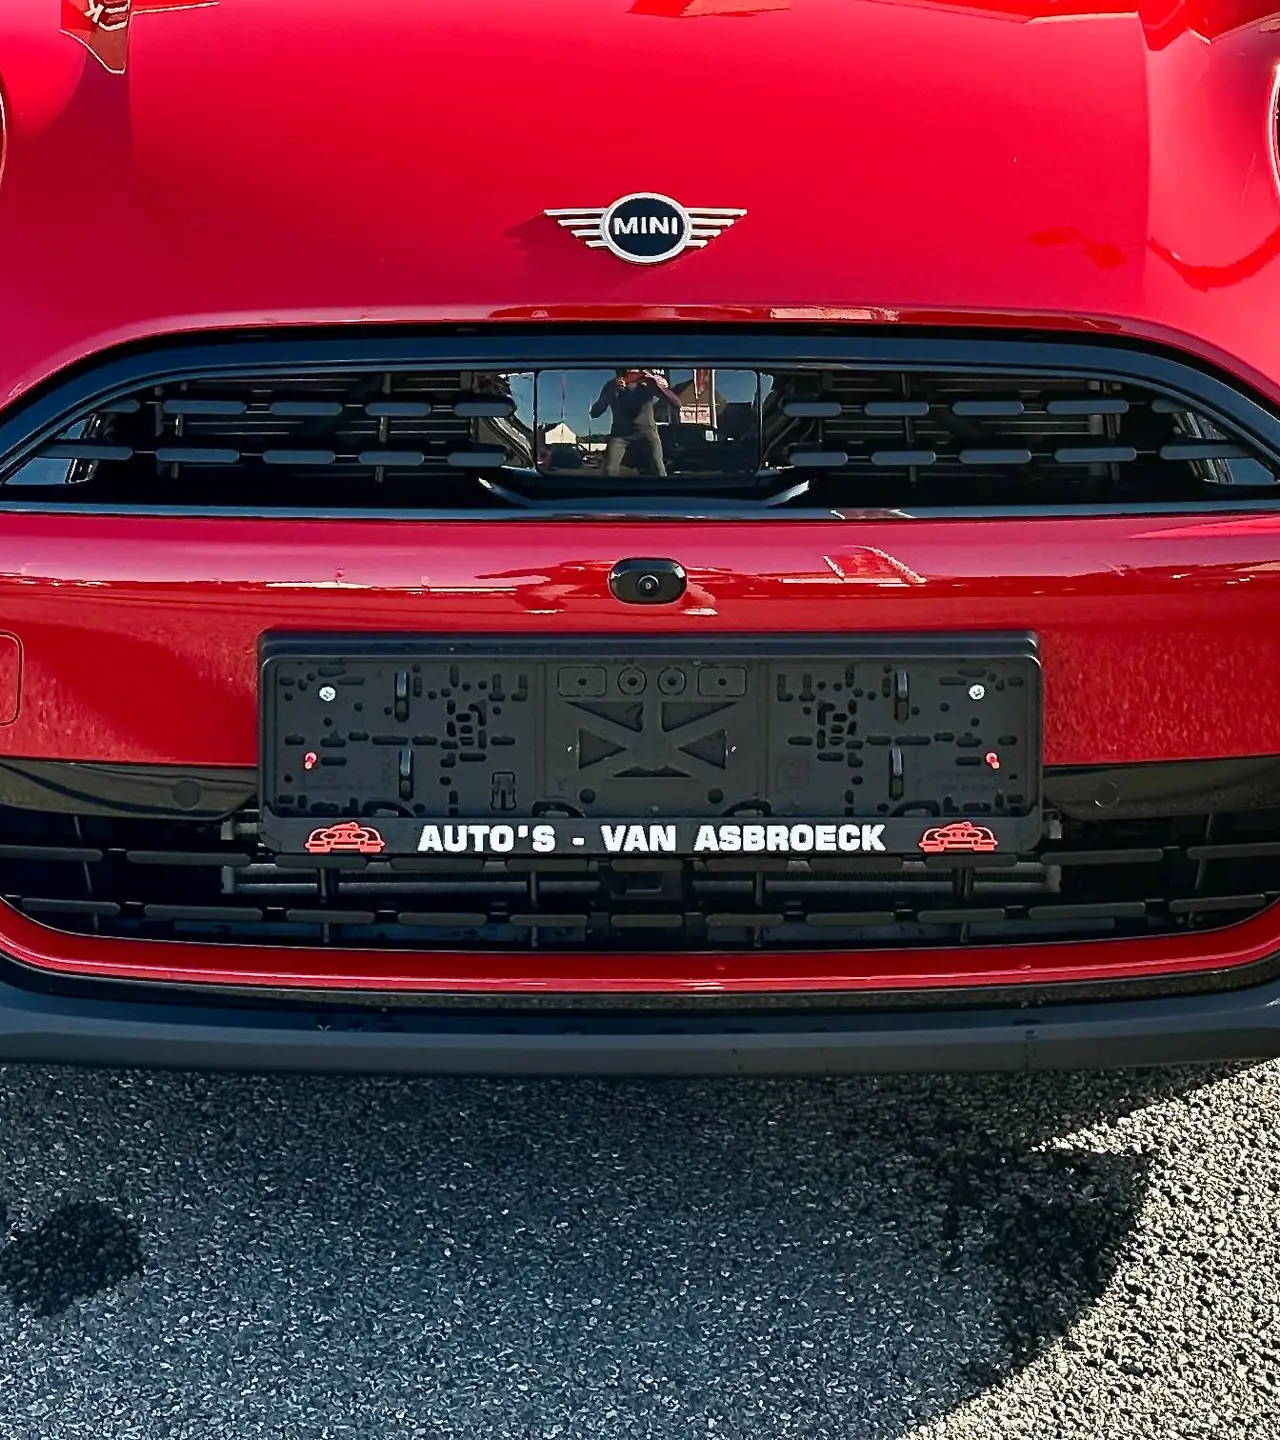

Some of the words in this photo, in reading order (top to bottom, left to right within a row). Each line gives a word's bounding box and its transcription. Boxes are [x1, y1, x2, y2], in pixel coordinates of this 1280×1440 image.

[613, 216, 679, 236] MINI
[418, 824, 556, 853] AUTO'S
[600, 824, 676, 853] VAN
[693, 824, 887, 853] ASBROECK
